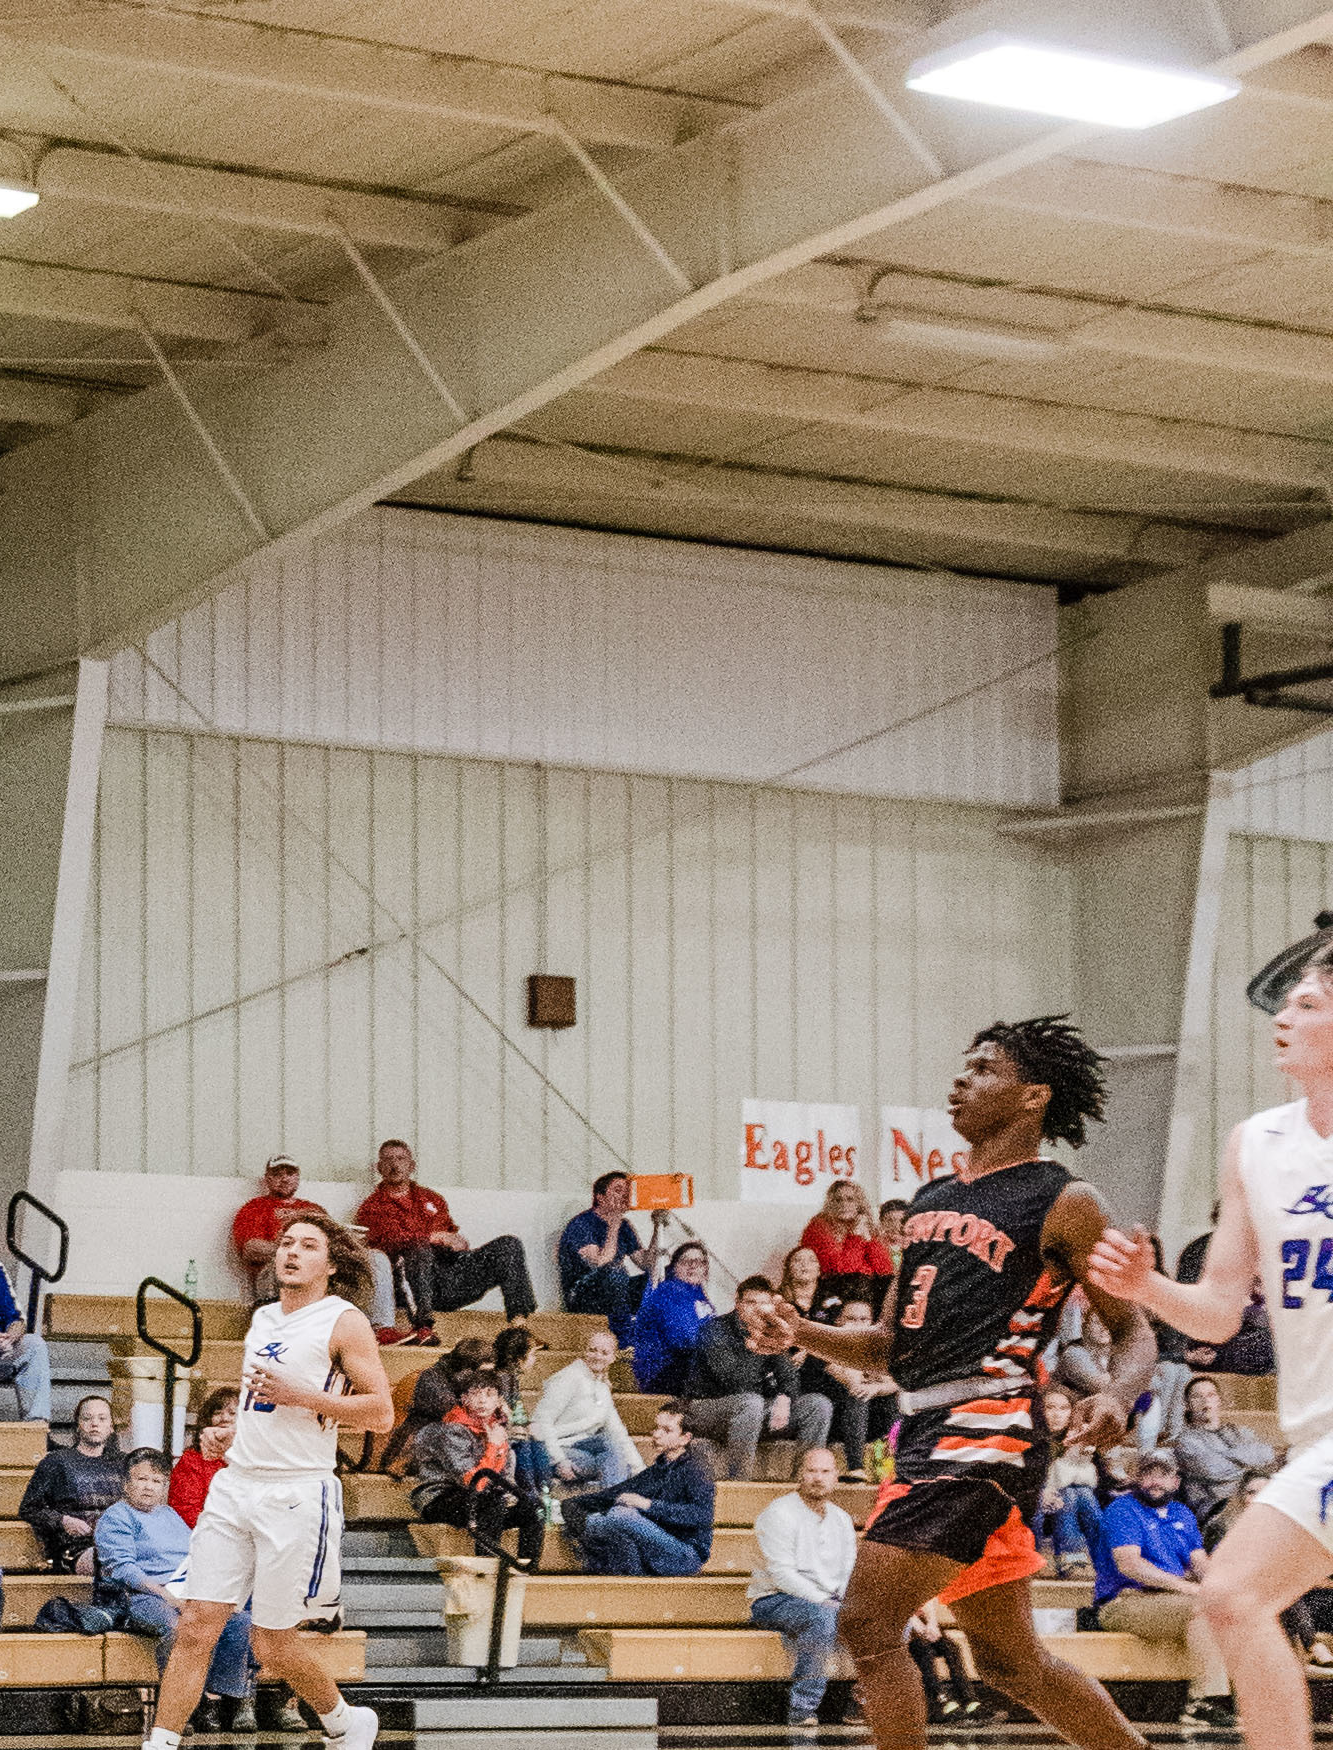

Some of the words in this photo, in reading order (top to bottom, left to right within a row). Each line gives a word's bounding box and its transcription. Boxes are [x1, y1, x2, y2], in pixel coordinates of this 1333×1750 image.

[743, 1123, 857, 1186] Eagles
[890, 1128, 971, 1182] Nes
[902, 1210, 1017, 1274] EWPORT
[900, 1264, 938, 1330] 3
